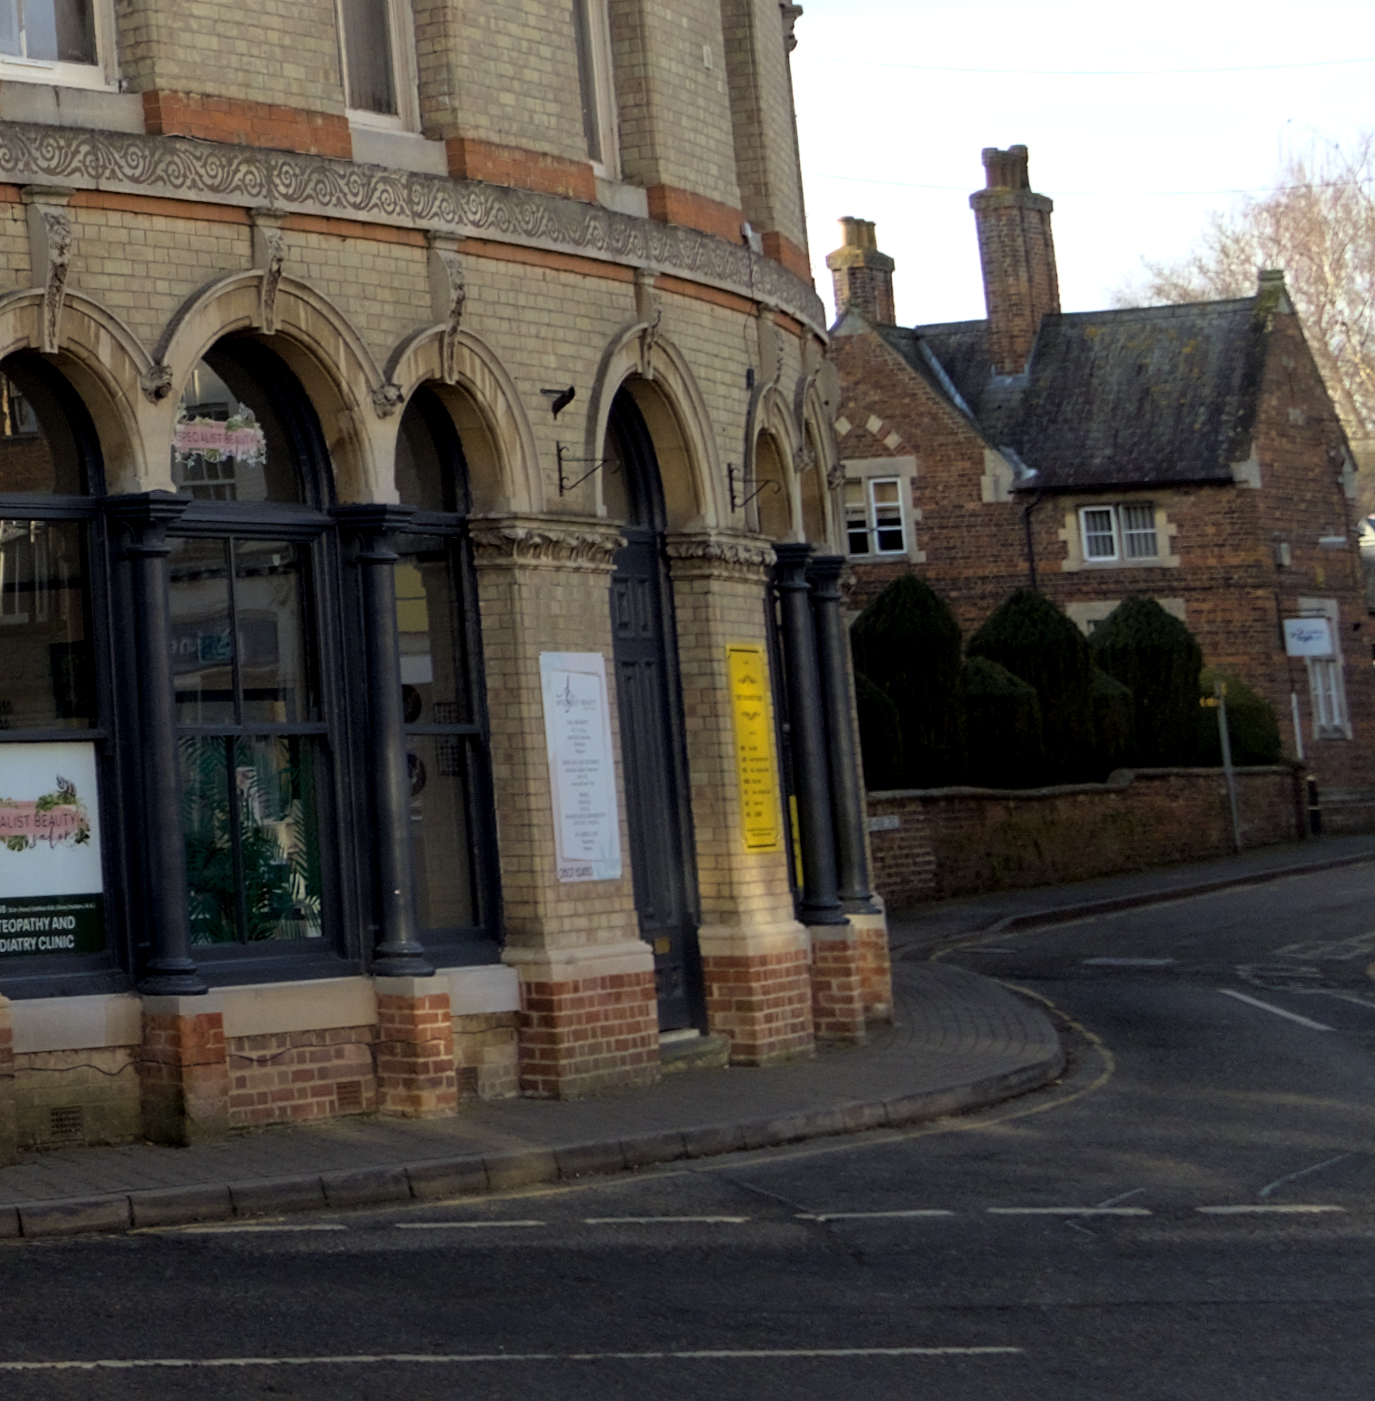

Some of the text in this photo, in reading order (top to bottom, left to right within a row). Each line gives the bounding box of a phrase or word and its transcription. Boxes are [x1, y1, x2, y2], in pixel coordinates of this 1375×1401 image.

[34, 813, 76, 828] BEAUTY
[51, 915, 77, 930] AND
[37, 934, 75, 950] CLINIC
